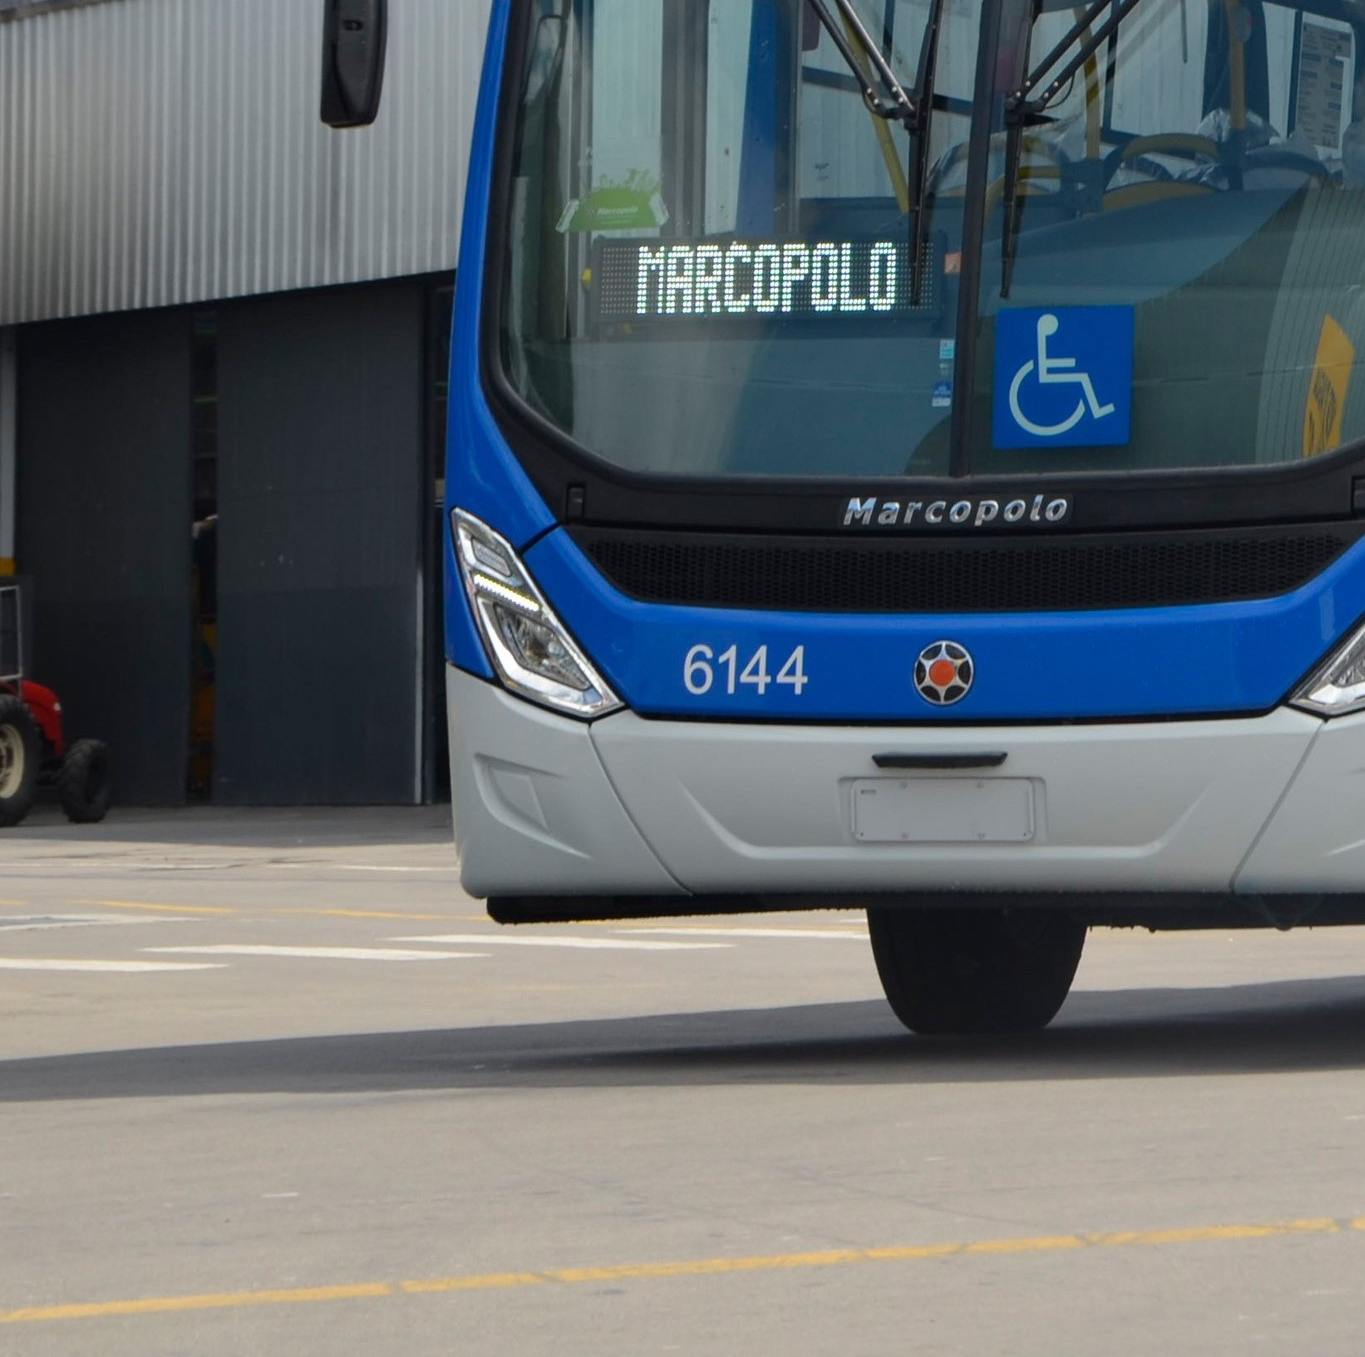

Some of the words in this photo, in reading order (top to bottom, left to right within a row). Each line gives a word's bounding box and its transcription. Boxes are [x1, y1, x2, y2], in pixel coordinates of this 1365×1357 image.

[636, 242, 896, 314] MARCOPOLO
[843, 494, 1068, 527] Marcopolo
[683, 643, 808, 696] 6144
